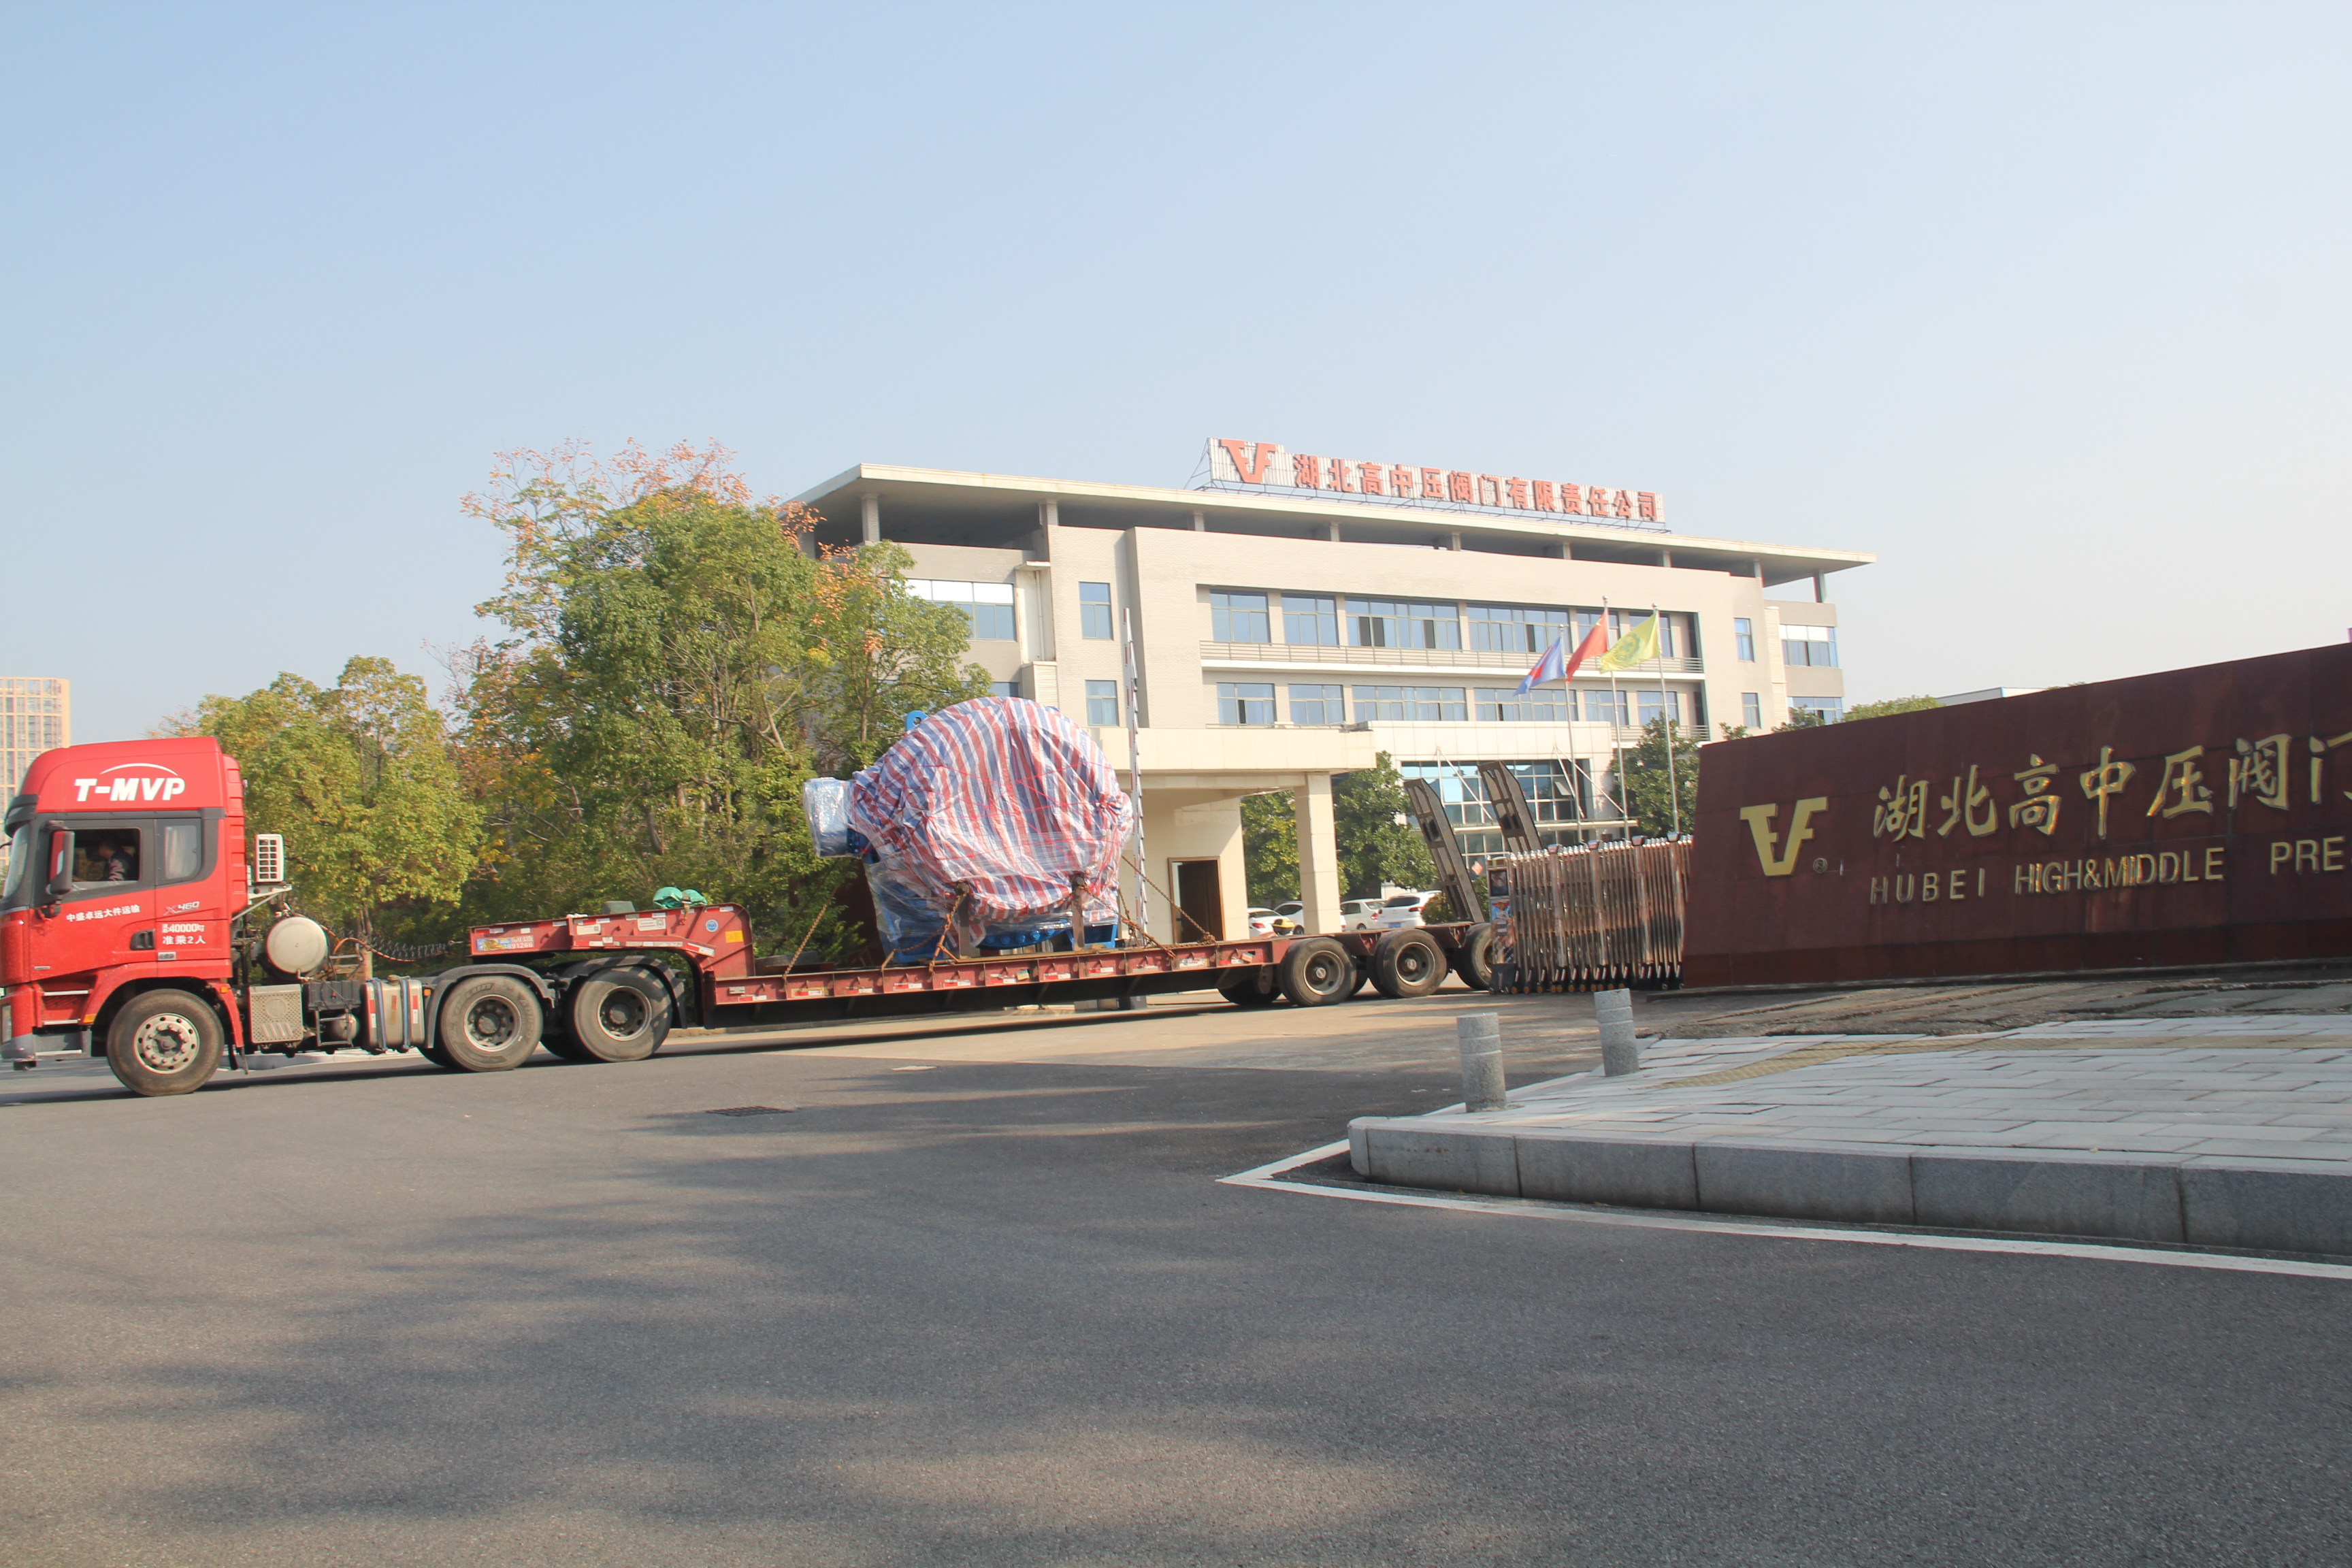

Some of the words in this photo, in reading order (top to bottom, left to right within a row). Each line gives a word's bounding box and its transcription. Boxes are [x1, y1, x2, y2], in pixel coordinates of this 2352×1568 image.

[1293, 453, 1657, 521] 湖北高中压阀门有限责任公司
[74, 777, 186, 802] T-MVP
[1870, 868, 1985, 905] HUBEI
[2014, 847, 2225, 895] HIGH&MIDDLE
[2270, 836, 2352, 876] PRE
[66, 904, 140, 922] 中盛卓远大件运输
[162, 934, 206, 945] 准乘2人
